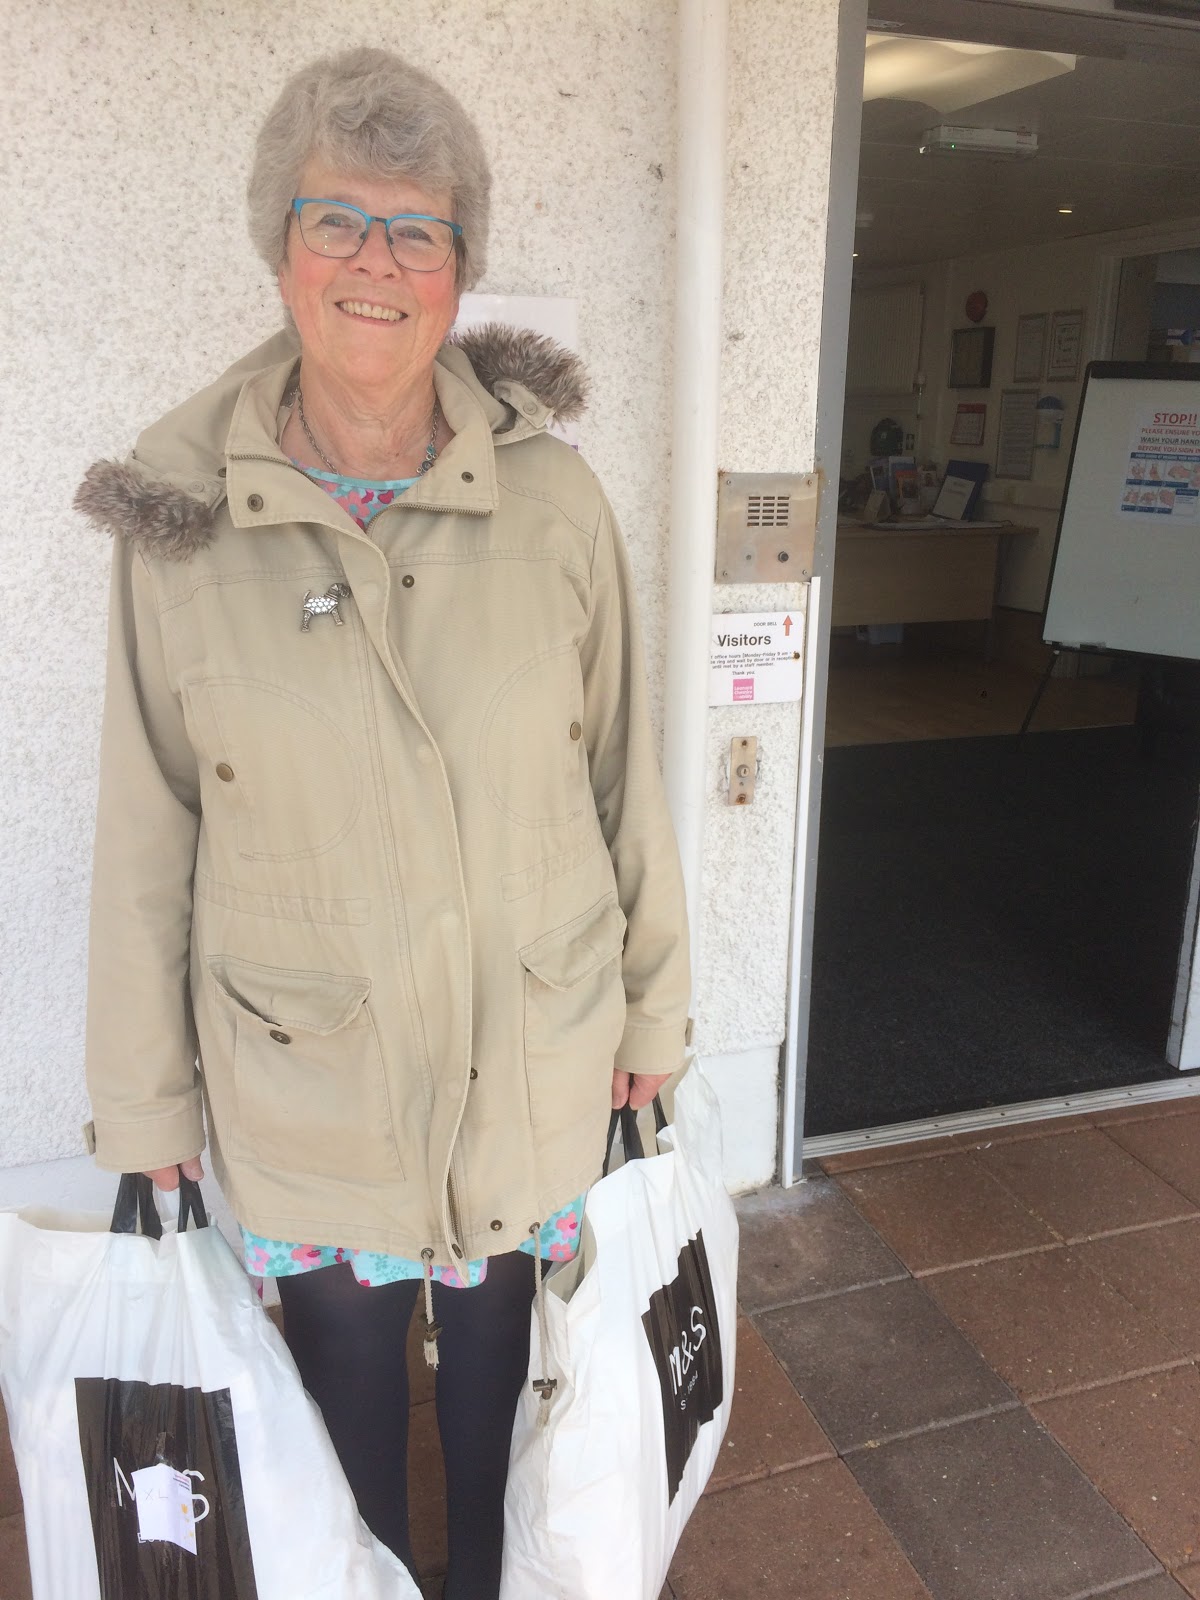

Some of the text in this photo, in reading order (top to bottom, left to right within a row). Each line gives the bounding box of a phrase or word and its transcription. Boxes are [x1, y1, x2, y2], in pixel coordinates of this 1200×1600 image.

[1154, 413, 1197, 424] STOP!!
[717, 633, 771, 647] Visitors
[669, 1306, 706, 1396] M&S
